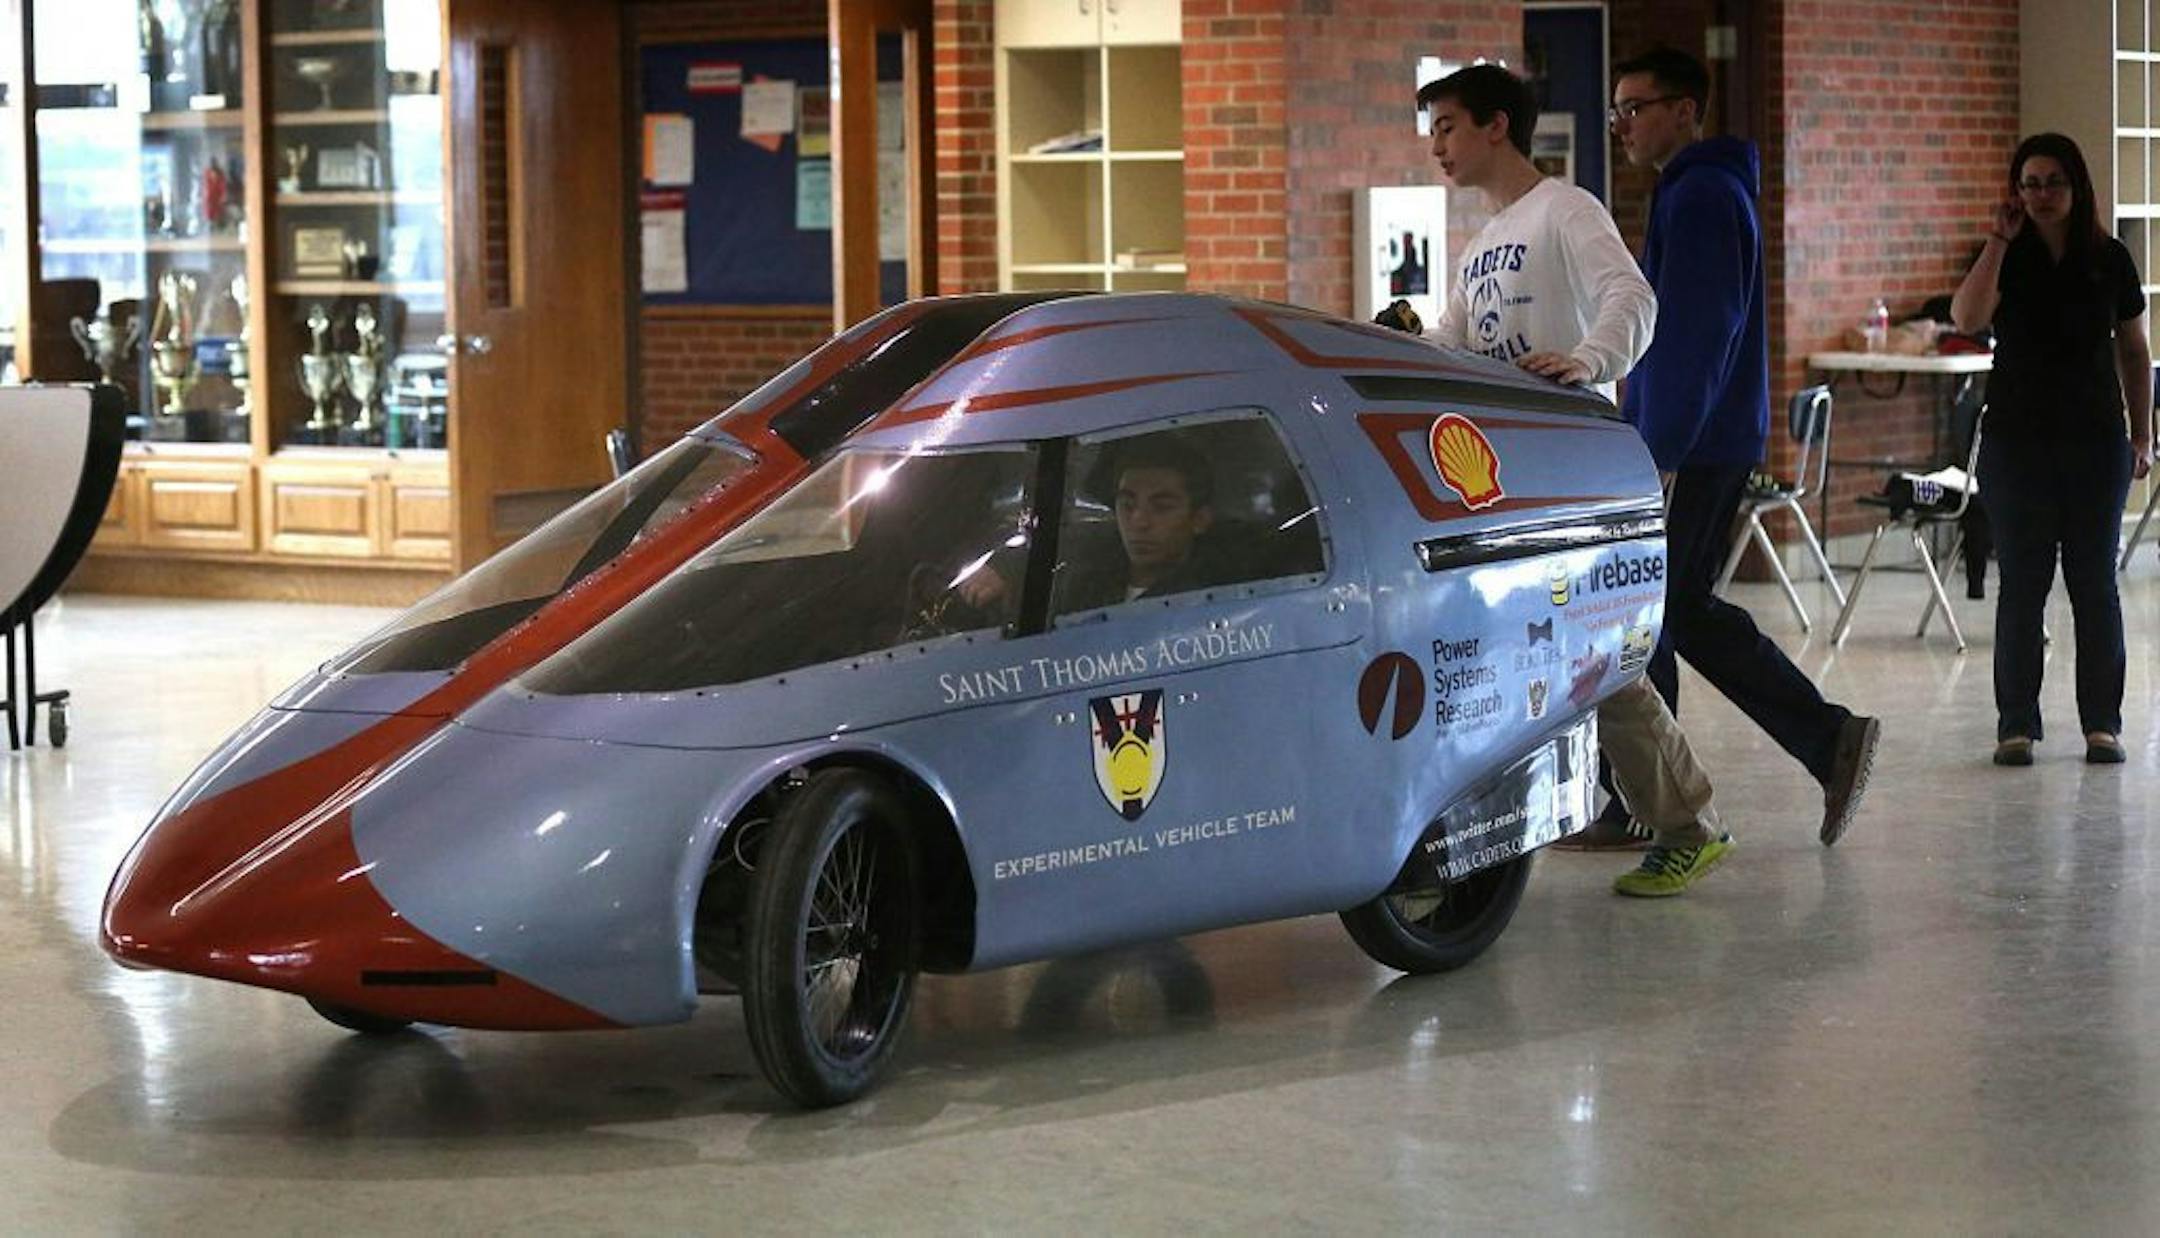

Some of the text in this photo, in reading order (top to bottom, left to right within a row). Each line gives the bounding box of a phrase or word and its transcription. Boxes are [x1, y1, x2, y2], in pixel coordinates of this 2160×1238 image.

[939, 624, 1274, 704] SAINT THOMAS ACADEMY
[1432, 638, 1479, 664] Power
[1434, 664, 1497, 698] Systems
[1436, 688, 1503, 726] Research
[994, 804, 1296, 880] EXPERIMENTAL VEHICLE TEAM
